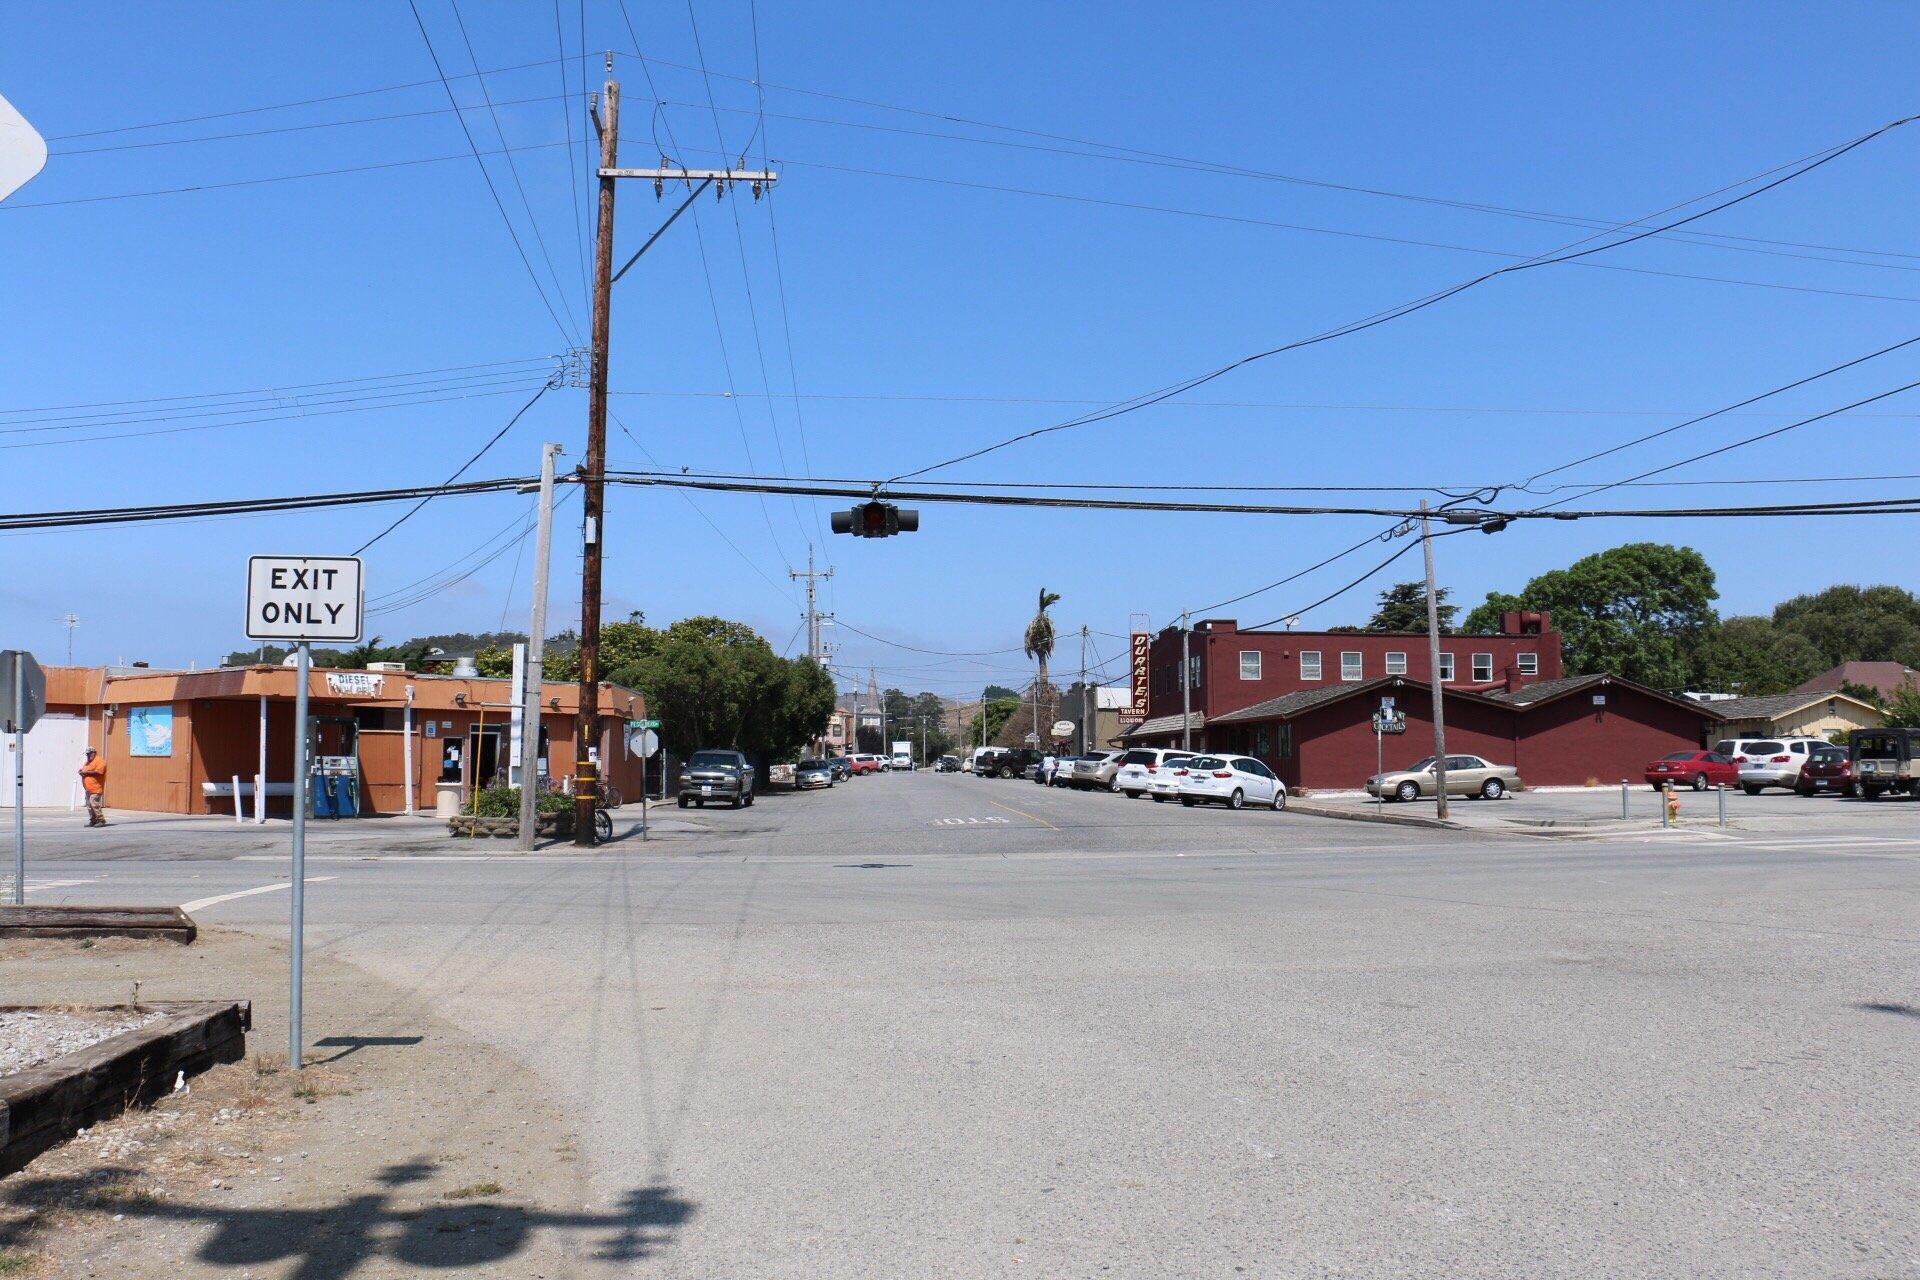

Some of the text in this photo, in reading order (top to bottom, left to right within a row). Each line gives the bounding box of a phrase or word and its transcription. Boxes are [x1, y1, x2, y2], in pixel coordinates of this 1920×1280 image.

[271, 568, 338, 590] EXIT
[262, 601, 344, 624] ONLY
[339, 675, 372, 684] DIESEL
[1134, 636, 1147, 708] DUARTE'S
